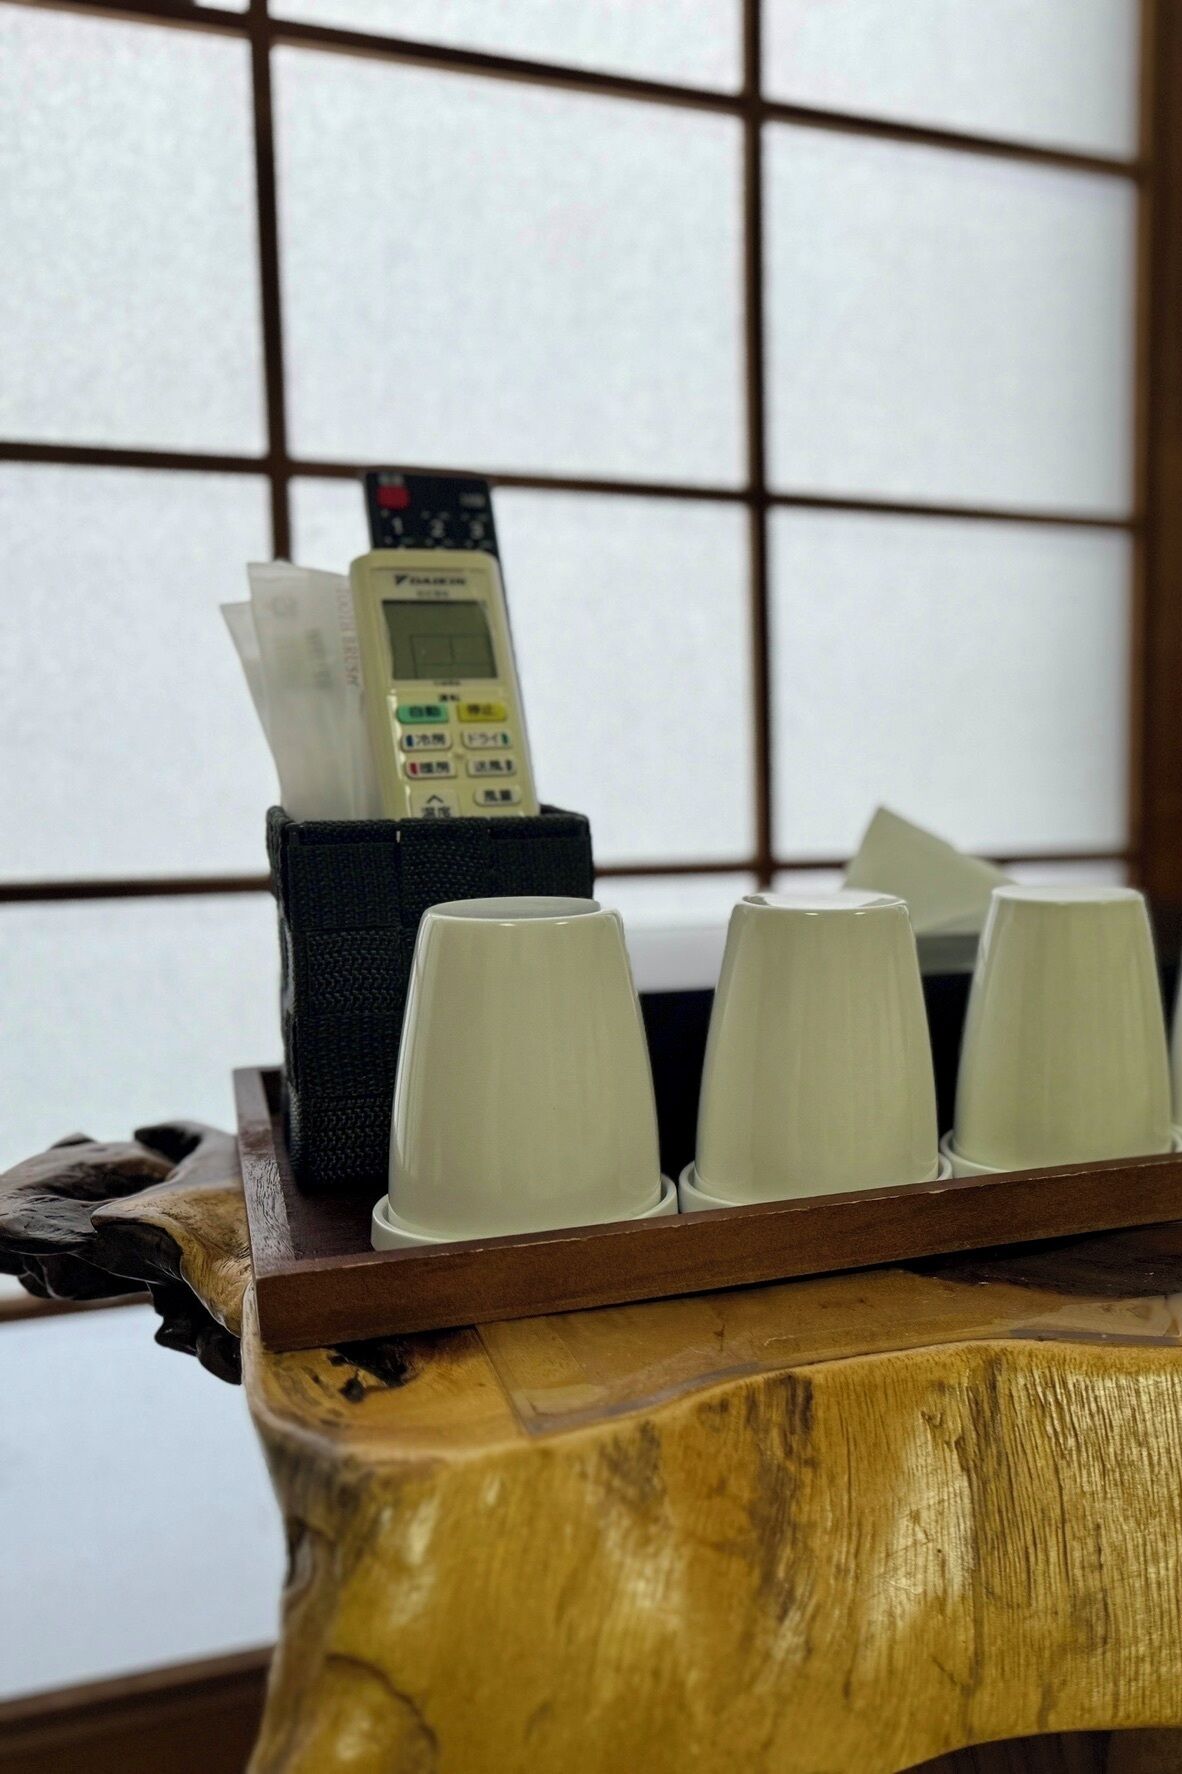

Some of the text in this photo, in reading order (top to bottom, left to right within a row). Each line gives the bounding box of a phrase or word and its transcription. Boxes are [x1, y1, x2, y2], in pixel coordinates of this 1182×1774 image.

[409, 577, 466, 586] DAIKIN
[416, 733, 446, 746] 冷房
[467, 732, 499, 745] ドライ
